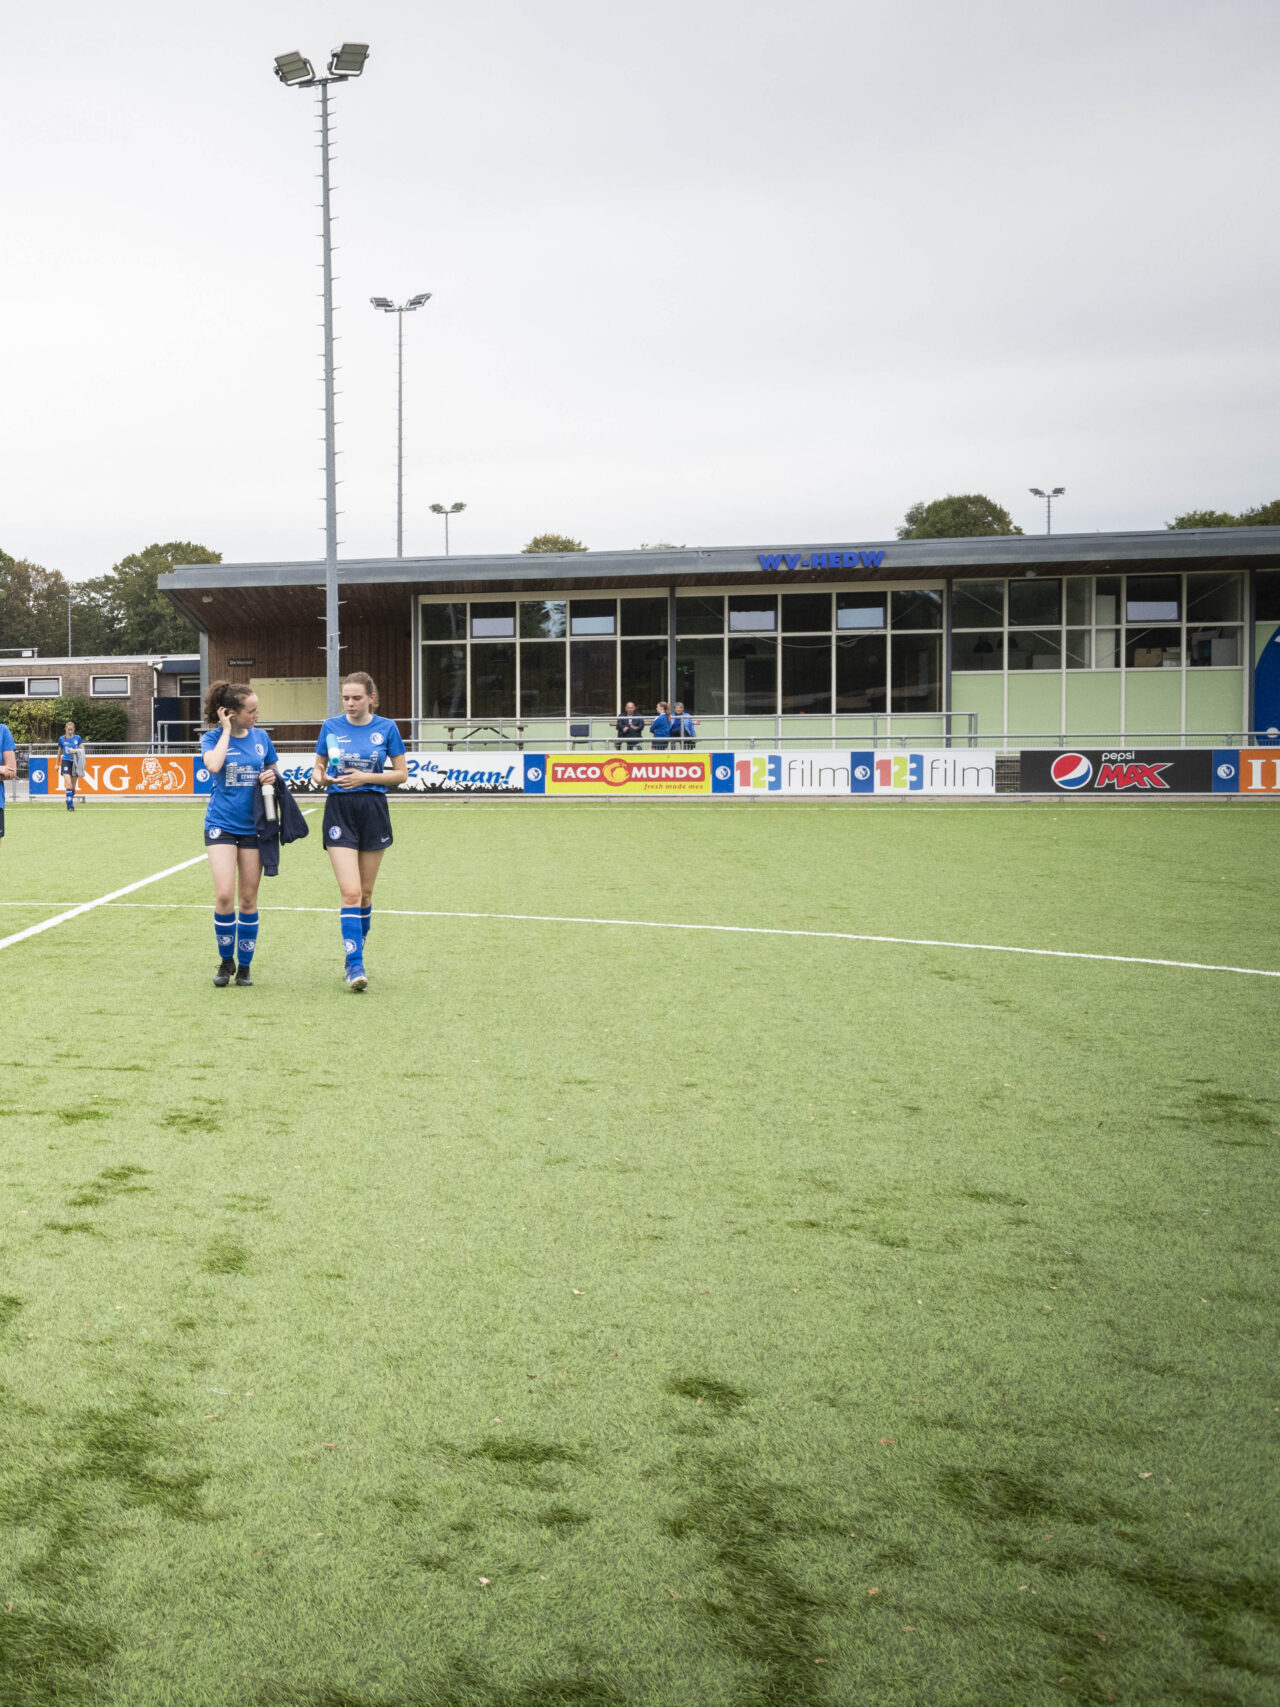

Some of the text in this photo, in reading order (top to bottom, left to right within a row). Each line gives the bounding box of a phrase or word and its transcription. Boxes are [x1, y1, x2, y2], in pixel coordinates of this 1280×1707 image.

[758, 551, 885, 571] WV-HEDW
[1101, 750, 1135, 761] pepsi
[446, 765, 515, 784] man!
[554, 766, 702, 779] TACO MUNDO
[735, 754, 850, 791] 123 film
[876, 753, 994, 791] 123 film
[1094, 762, 1174, 790] MAX
[643, 783, 663, 791] fresh
